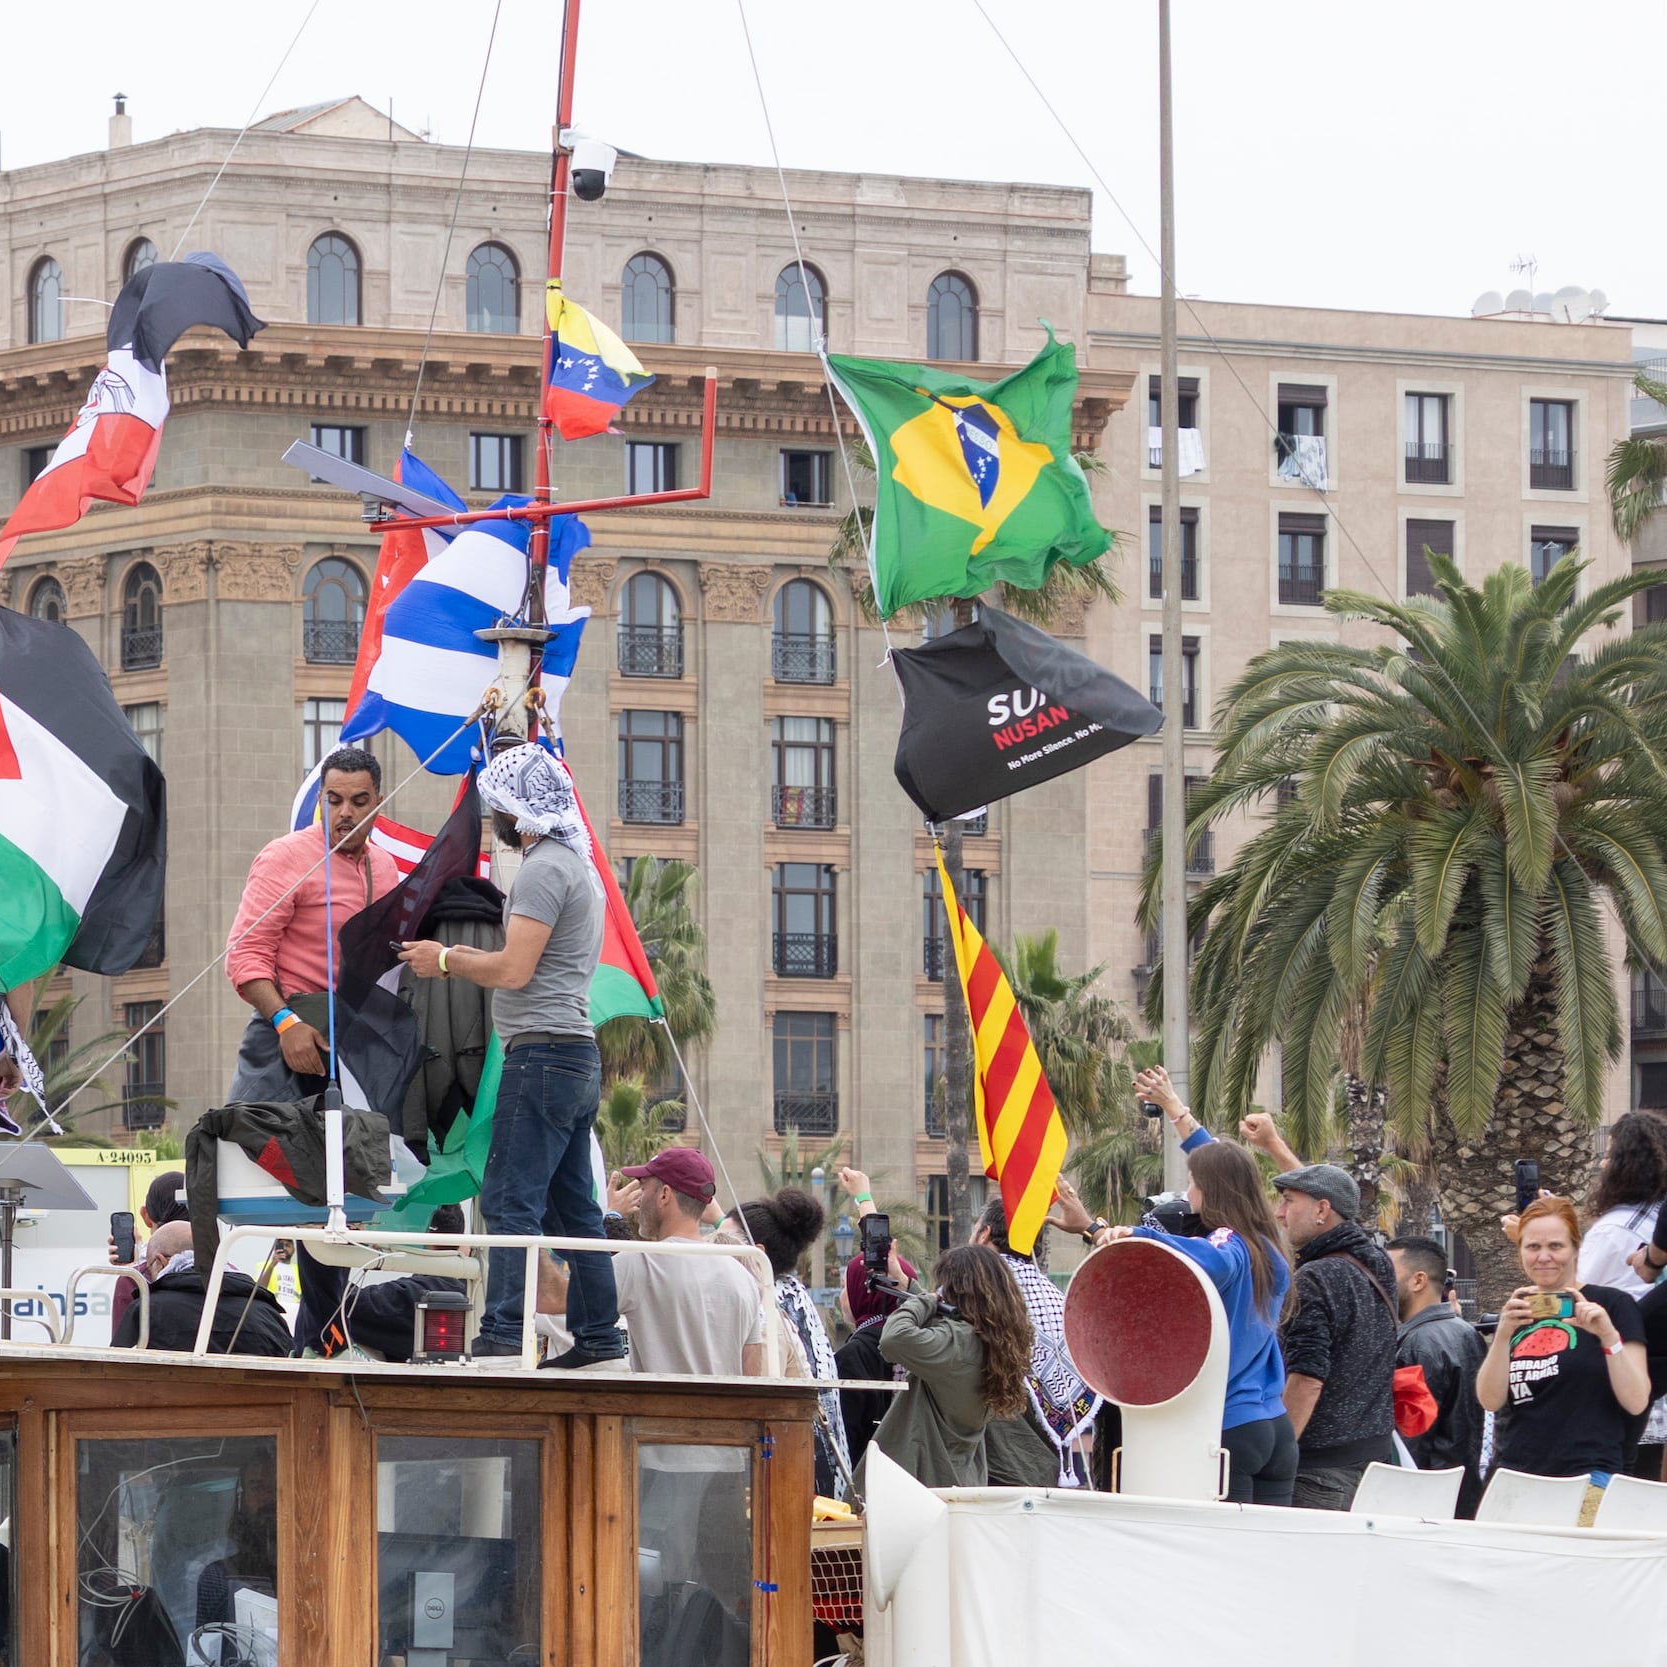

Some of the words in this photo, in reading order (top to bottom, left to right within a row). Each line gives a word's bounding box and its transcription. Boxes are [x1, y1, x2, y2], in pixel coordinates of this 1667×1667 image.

[987, 687, 1046, 726] SU
[992, 705, 1079, 750] NUSAN
[1007, 759, 1021, 770] No
[1022, 750, 1044, 765] More
[1075, 729, 1089, 740] No
[1510, 1371, 1524, 1383] DE
[1524, 1364, 1560, 1382] ARMAS
[1510, 1382, 1533, 1400] YA
